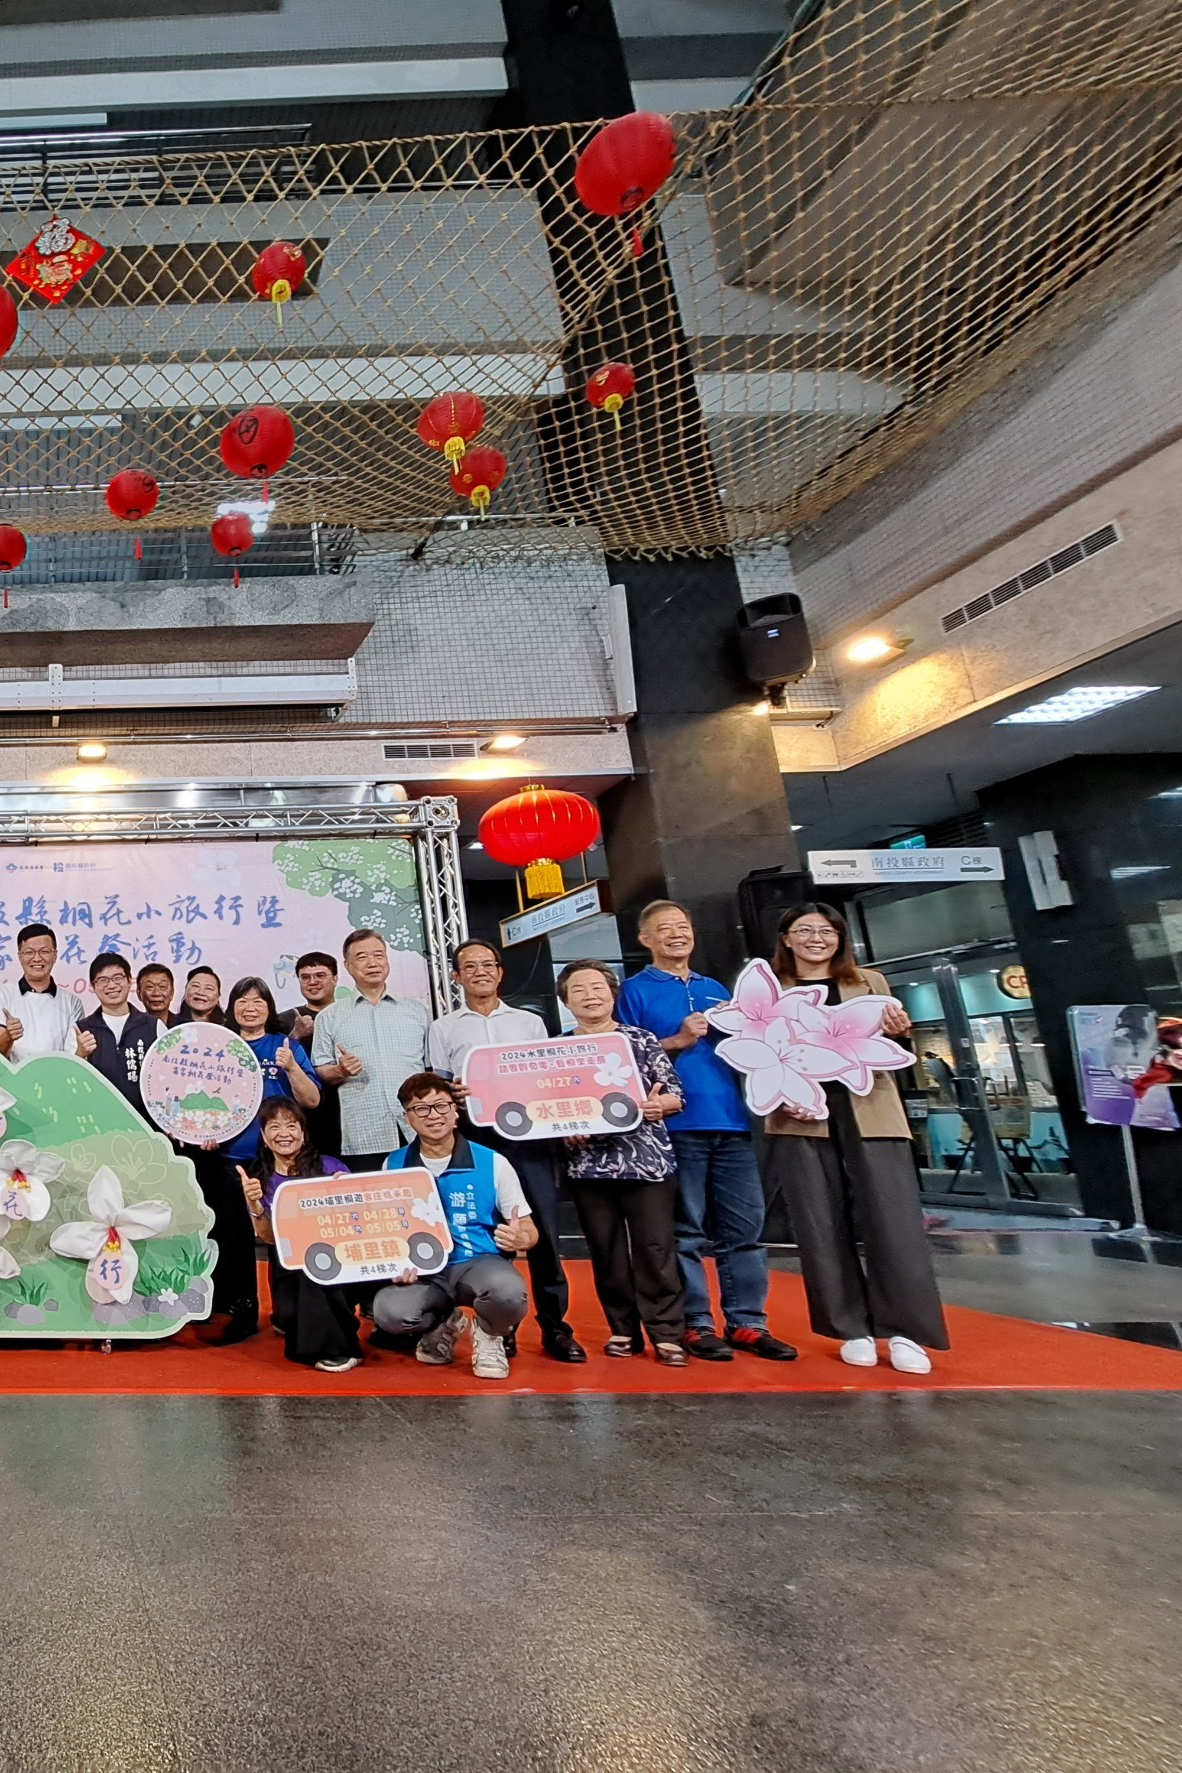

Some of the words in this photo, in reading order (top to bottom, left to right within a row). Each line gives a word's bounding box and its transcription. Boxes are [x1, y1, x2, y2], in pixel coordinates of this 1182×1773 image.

[871, 856, 945, 868] 南投縣政府
[180, 1045, 226, 1062] 2024
[535, 1099, 594, 1120] 水里鄉
[551, 1120, 591, 1132] 共4梯次
[344, 1240, 402, 1262] 埔里鎮
[359, 1262, 398, 1276] 共4梯次
